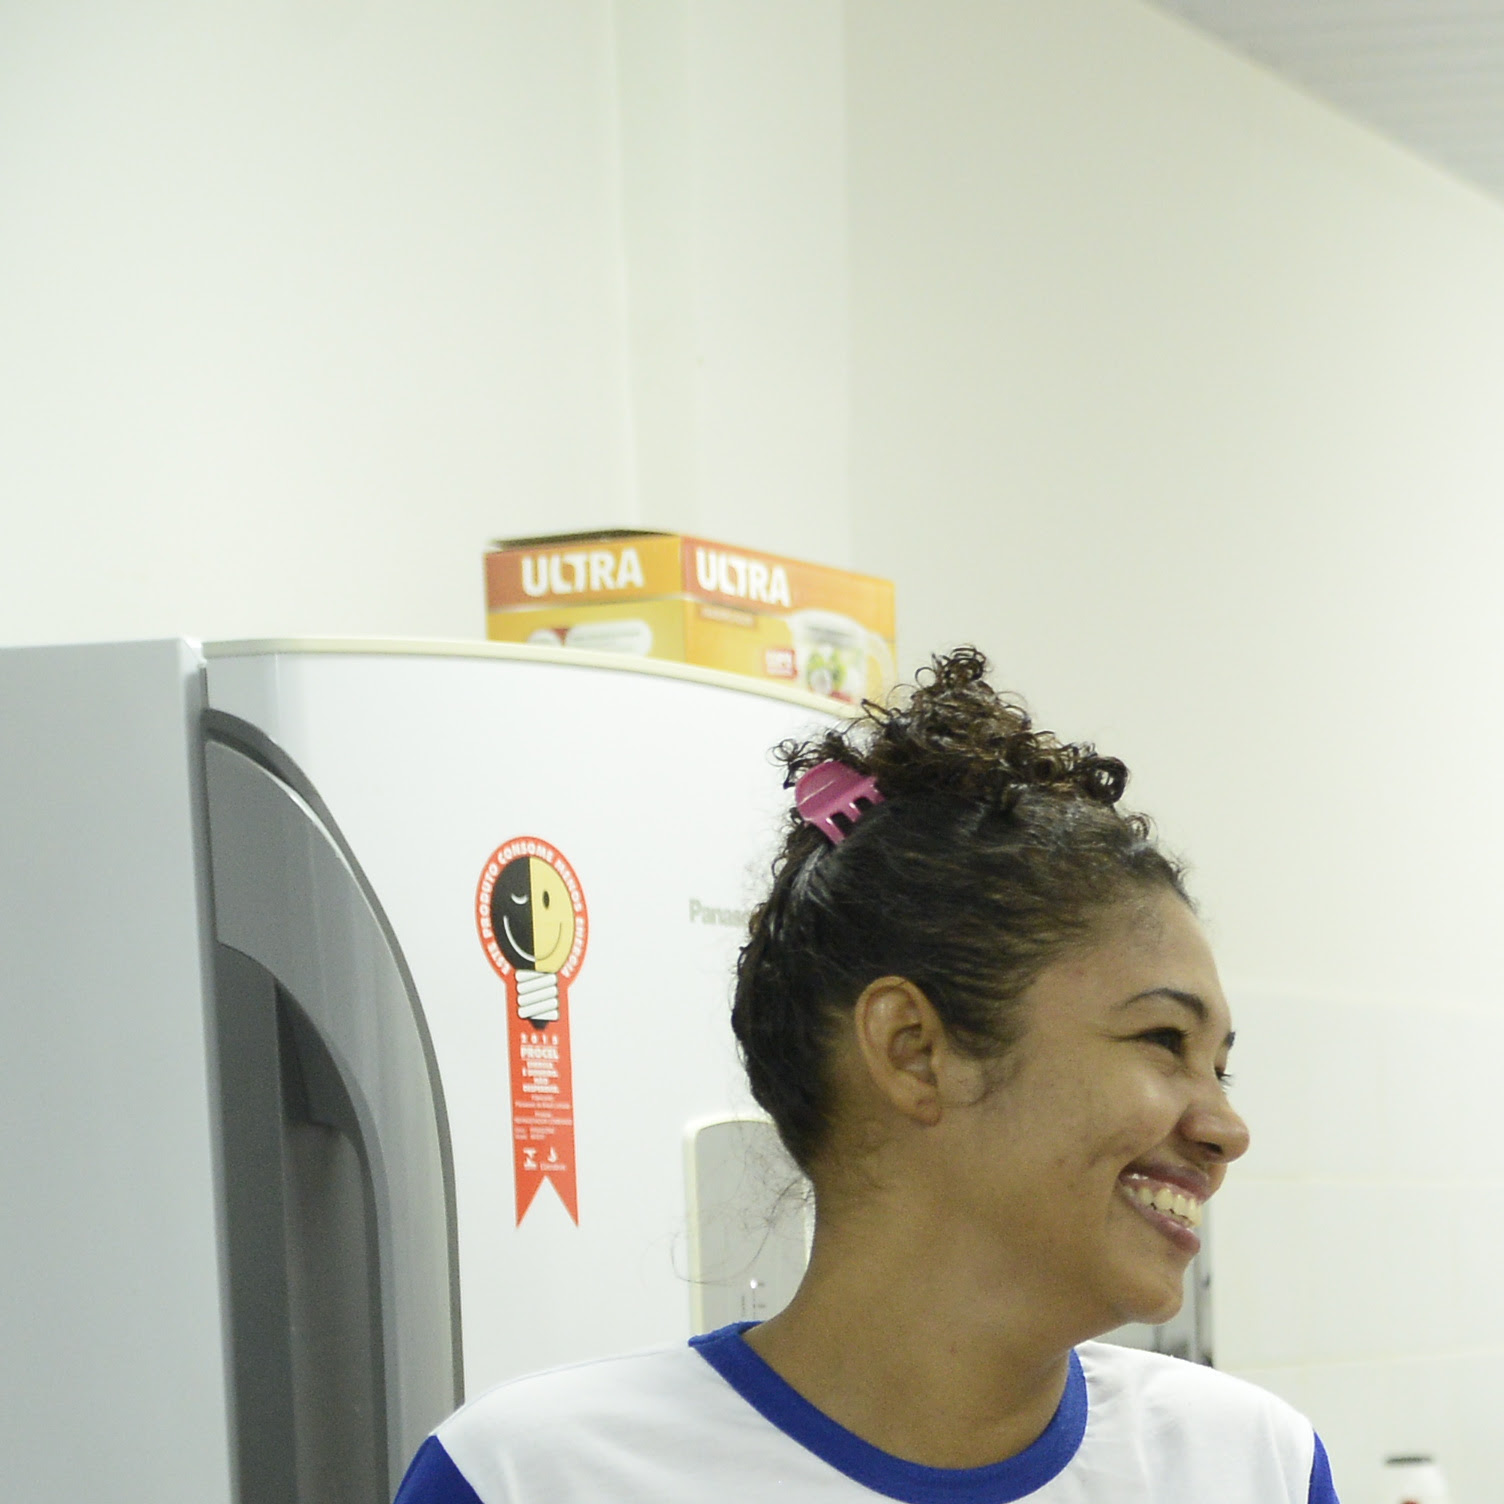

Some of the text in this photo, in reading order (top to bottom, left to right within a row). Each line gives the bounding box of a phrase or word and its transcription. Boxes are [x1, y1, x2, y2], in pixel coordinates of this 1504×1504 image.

[521, 547, 645, 597] ULTRA
[696, 547, 791, 608] ULTRA
[479, 842, 584, 978] ESTE PRODUTO CONSOME MENOS ENERGIA
